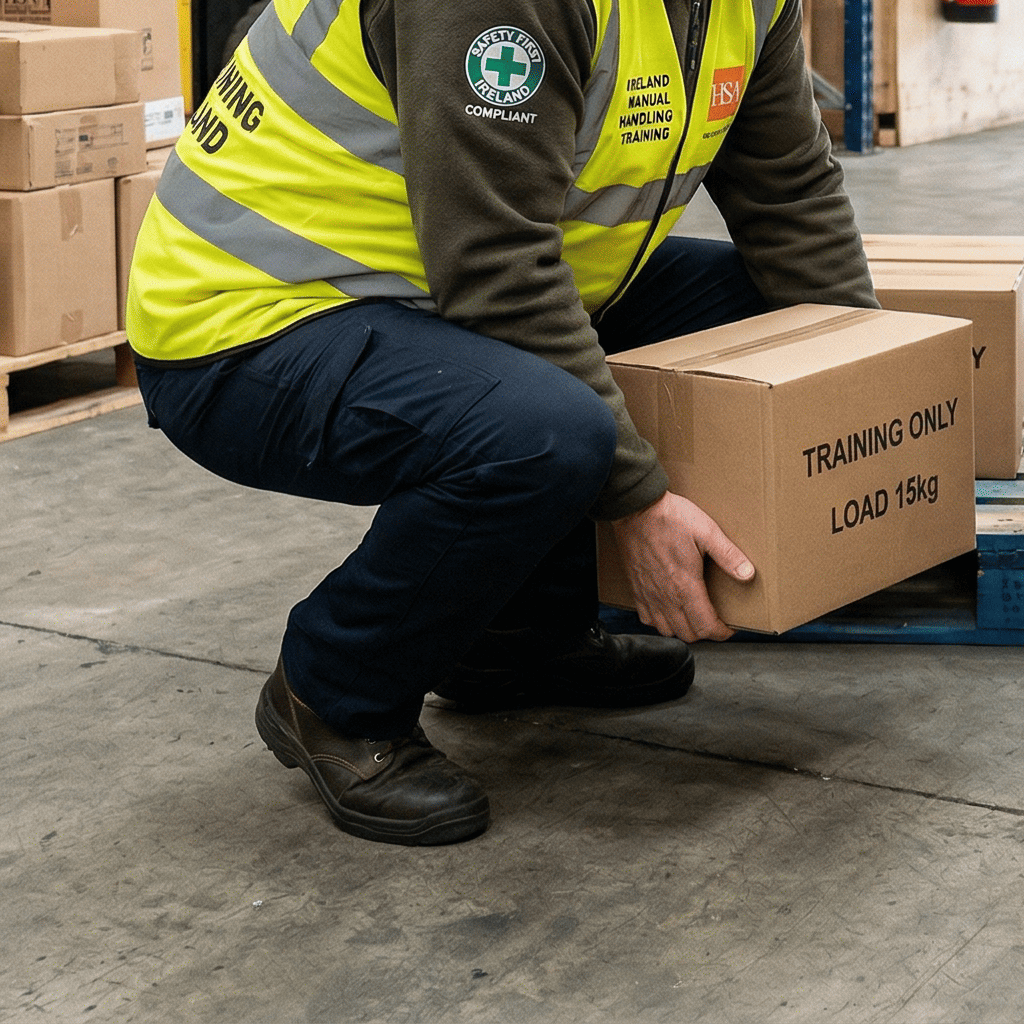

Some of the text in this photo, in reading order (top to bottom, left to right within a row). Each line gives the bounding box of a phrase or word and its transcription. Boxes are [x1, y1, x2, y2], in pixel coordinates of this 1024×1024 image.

[471, 30, 515, 57] SAFETY
[474, 79, 530, 103] IRELAND
[626, 74, 670, 91] IRELAND
[711, 81, 740, 107] HSA
[464, 104, 538, 124] COMPLIANT
[621, 127, 670, 145] TRAINING
[802, 397, 958, 478] TRAINING ONLY
[831, 474, 939, 535] LOAD 15kg
